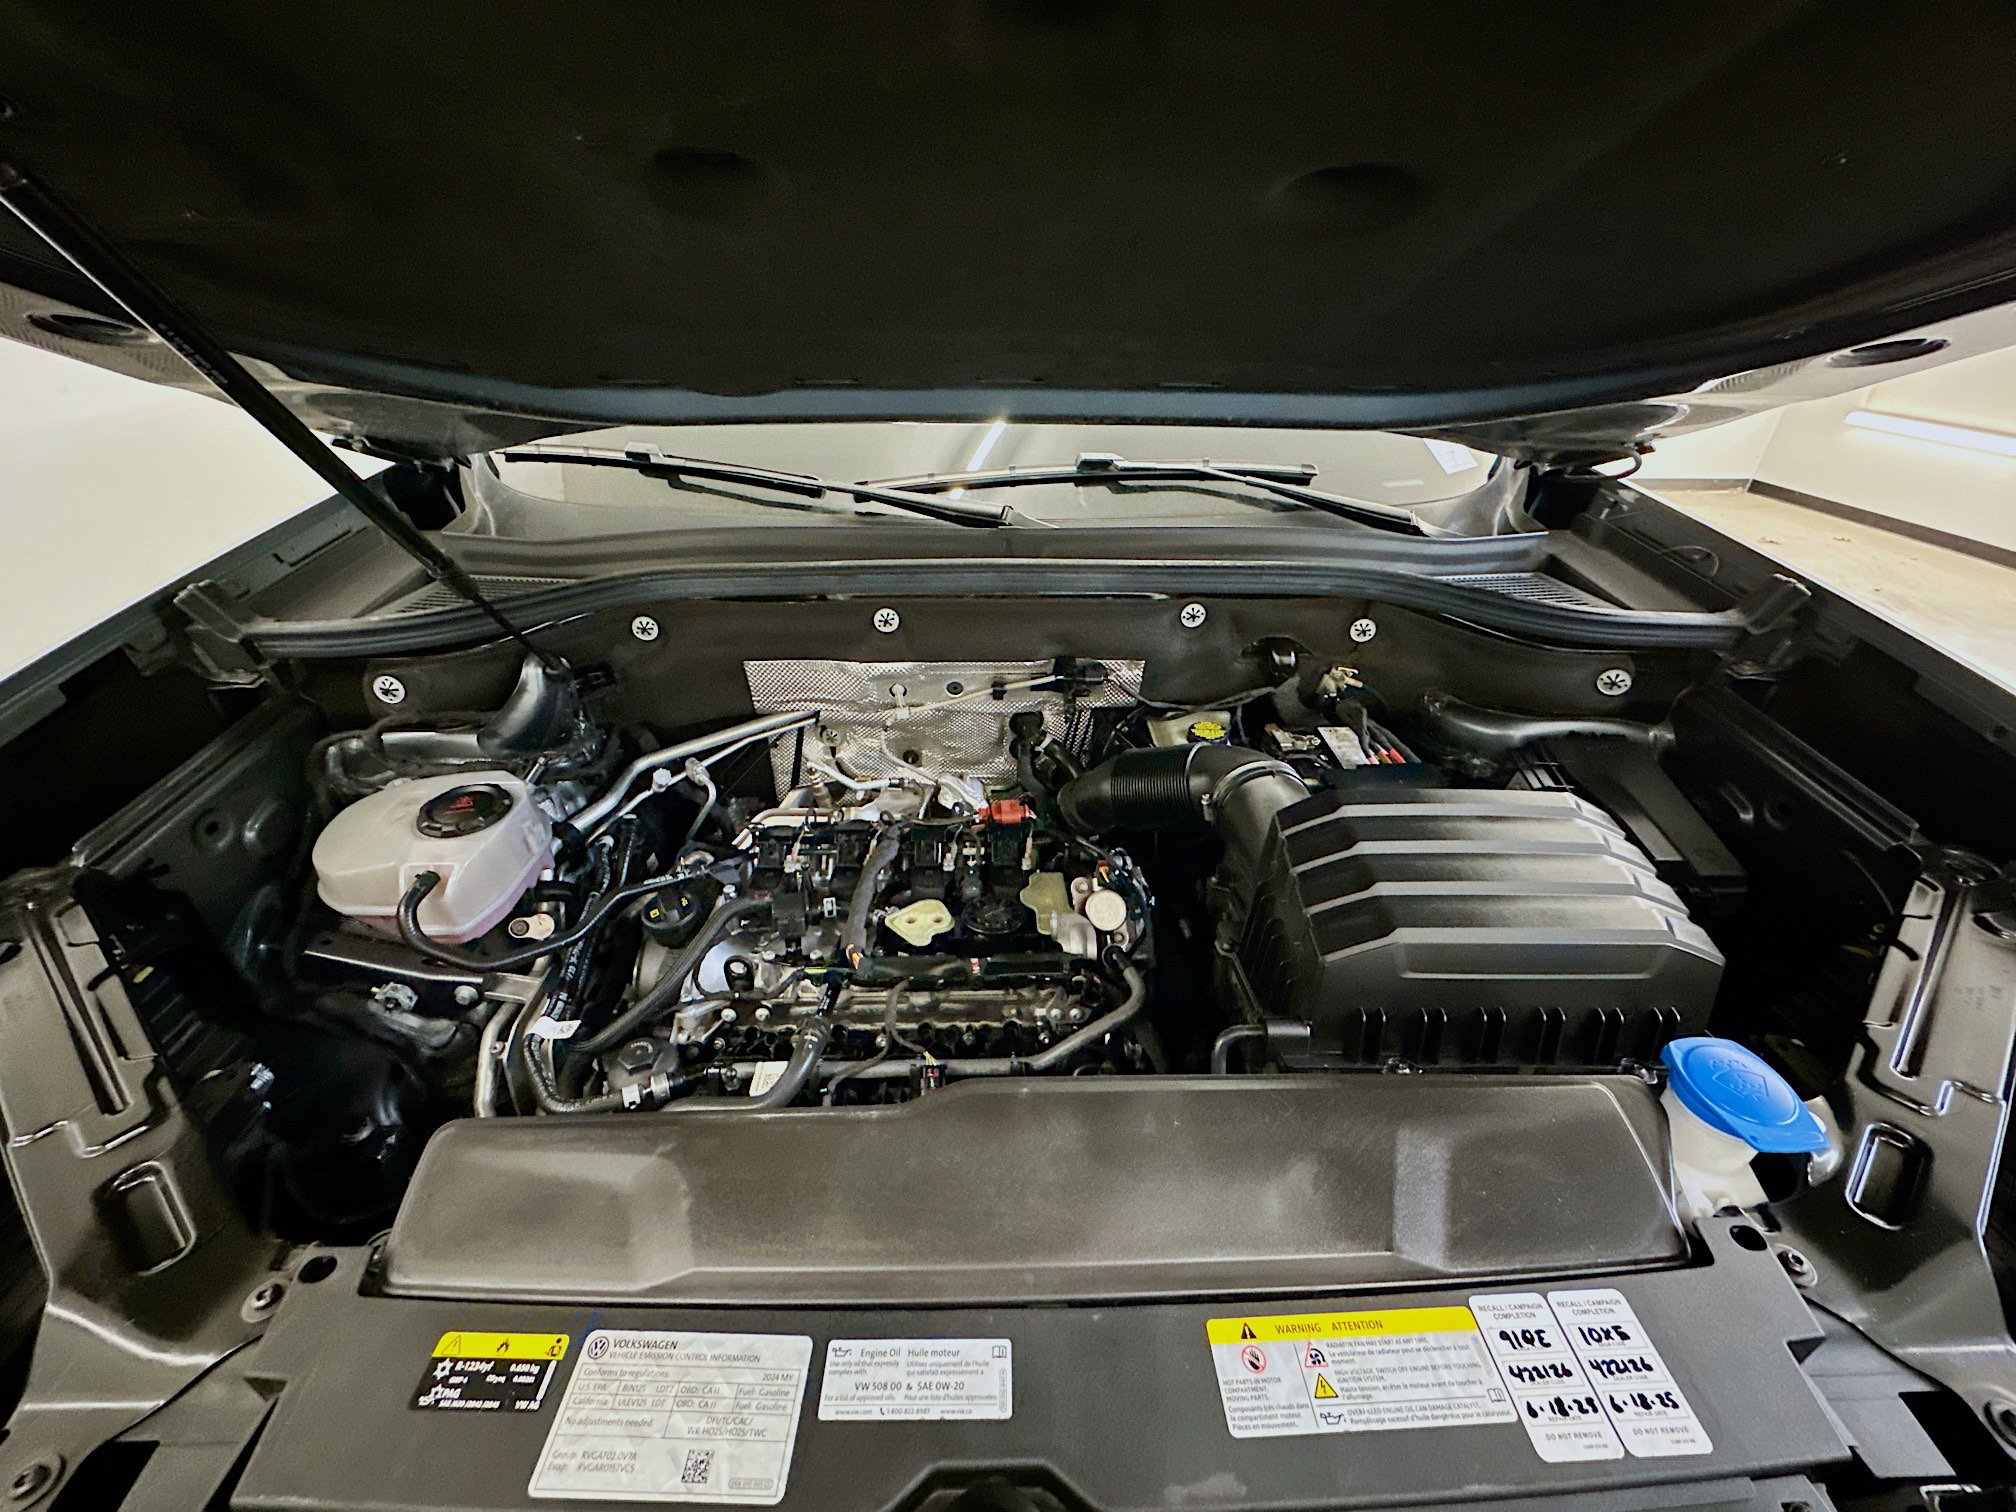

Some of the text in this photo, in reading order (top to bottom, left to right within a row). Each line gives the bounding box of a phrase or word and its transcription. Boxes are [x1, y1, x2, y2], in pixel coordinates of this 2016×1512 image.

[1275, 1321, 1383, 1334] WARNING ATTENTION
[614, 1339, 678, 1350] VOLKSWAGEN
[675, 1352, 707, 1360] CONTROL
[710, 1354, 760, 1362] INFORMATION
[861, 1348, 900, 1359] Engine Oil
[908, 1349, 928, 1357] Huile
[584, 1368, 617, 1377] Conforms
[763, 1373, 779, 1381] 2024
[872, 1382, 888, 1390] 508
[890, 1382, 902, 1390] 00
[917, 1382, 933, 1390] SAE
[935, 1382, 964, 1390] 0W-20
[759, 1389, 790, 1397] Gasoline
[756, 1402, 787, 1411] Gasoline
[1237, 1413, 1278, 1422] compartiment
[577, 1417, 624, 1430] adjustments
[625, 1418, 652, 1427] needed
